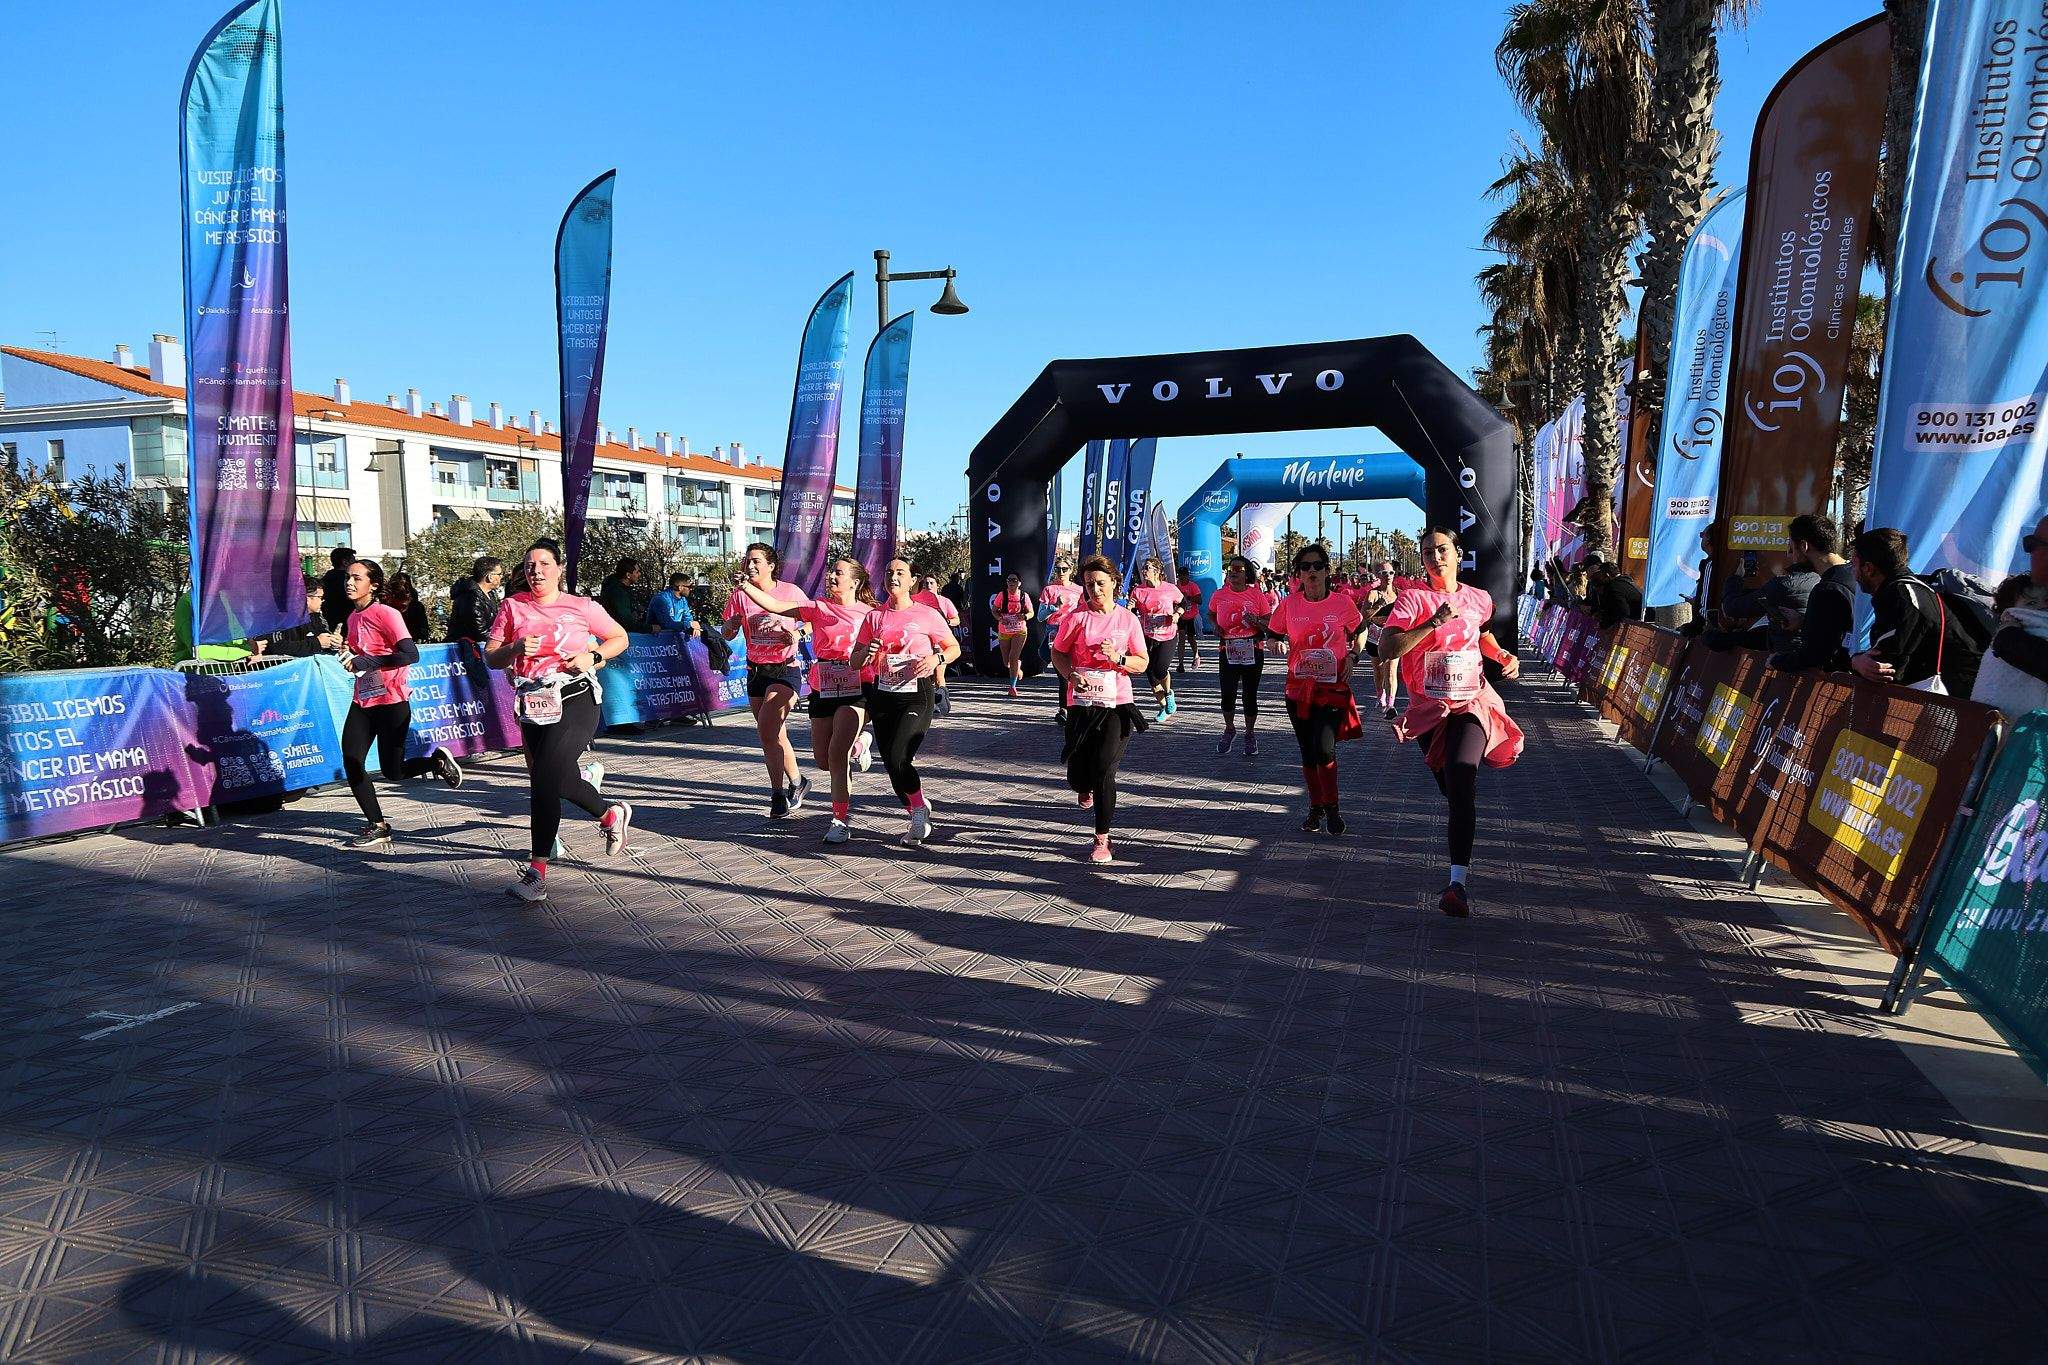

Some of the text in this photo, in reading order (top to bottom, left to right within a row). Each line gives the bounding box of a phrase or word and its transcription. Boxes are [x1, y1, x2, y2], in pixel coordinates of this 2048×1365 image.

[1966, 19, 2018, 184] Institutos
[250, 186, 267, 202] EL
[194, 207, 239, 224] CÁNCER
[251, 208, 286, 224] MAMA
[1790, 170, 1832, 342] Odontológicos
[1765, 230, 1796, 344] Institutos
[1827, 216, 1854, 340] Clínicas dentales
[1705, 290, 1730, 402] Odontológicos
[1687, 328, 1707, 402] Institutos
[1096, 369, 1345, 404] VOLVO
[217, 411, 269, 431] SÚMATE
[1917, 401, 2038, 427] 900 131 002
[217, 433, 277, 447] MOVIMIENTO
[1915, 421, 2036, 445] www.ioa.es
[1282, 460, 1365, 497] Marlene
[1106, 480, 1118, 540] GOYA
[1128, 489, 1144, 545] GOYA
[1670, 500, 1689, 508] 900
[1459, 467, 1477, 572] LVO
[1733, 521, 1783, 533] 900 131
[1443, 673, 1463, 682] 016
[429, 684, 447, 700] EL
[529, 700, 548, 709] 016
[440, 703, 454, 719] DE
[454, 699, 486, 718] MAMA
[54, 727, 84, 748] EL
[413, 720, 485, 746] METASTÁSICO
[67, 753, 95, 776] DE
[94, 746, 149, 771] MAMA
[281, 743, 311, 759] SÚMATE
[10, 775, 146, 814] METASTÁSICO
[1831, 747, 1865, 785] 900
[1884, 773, 1923, 819] 002
